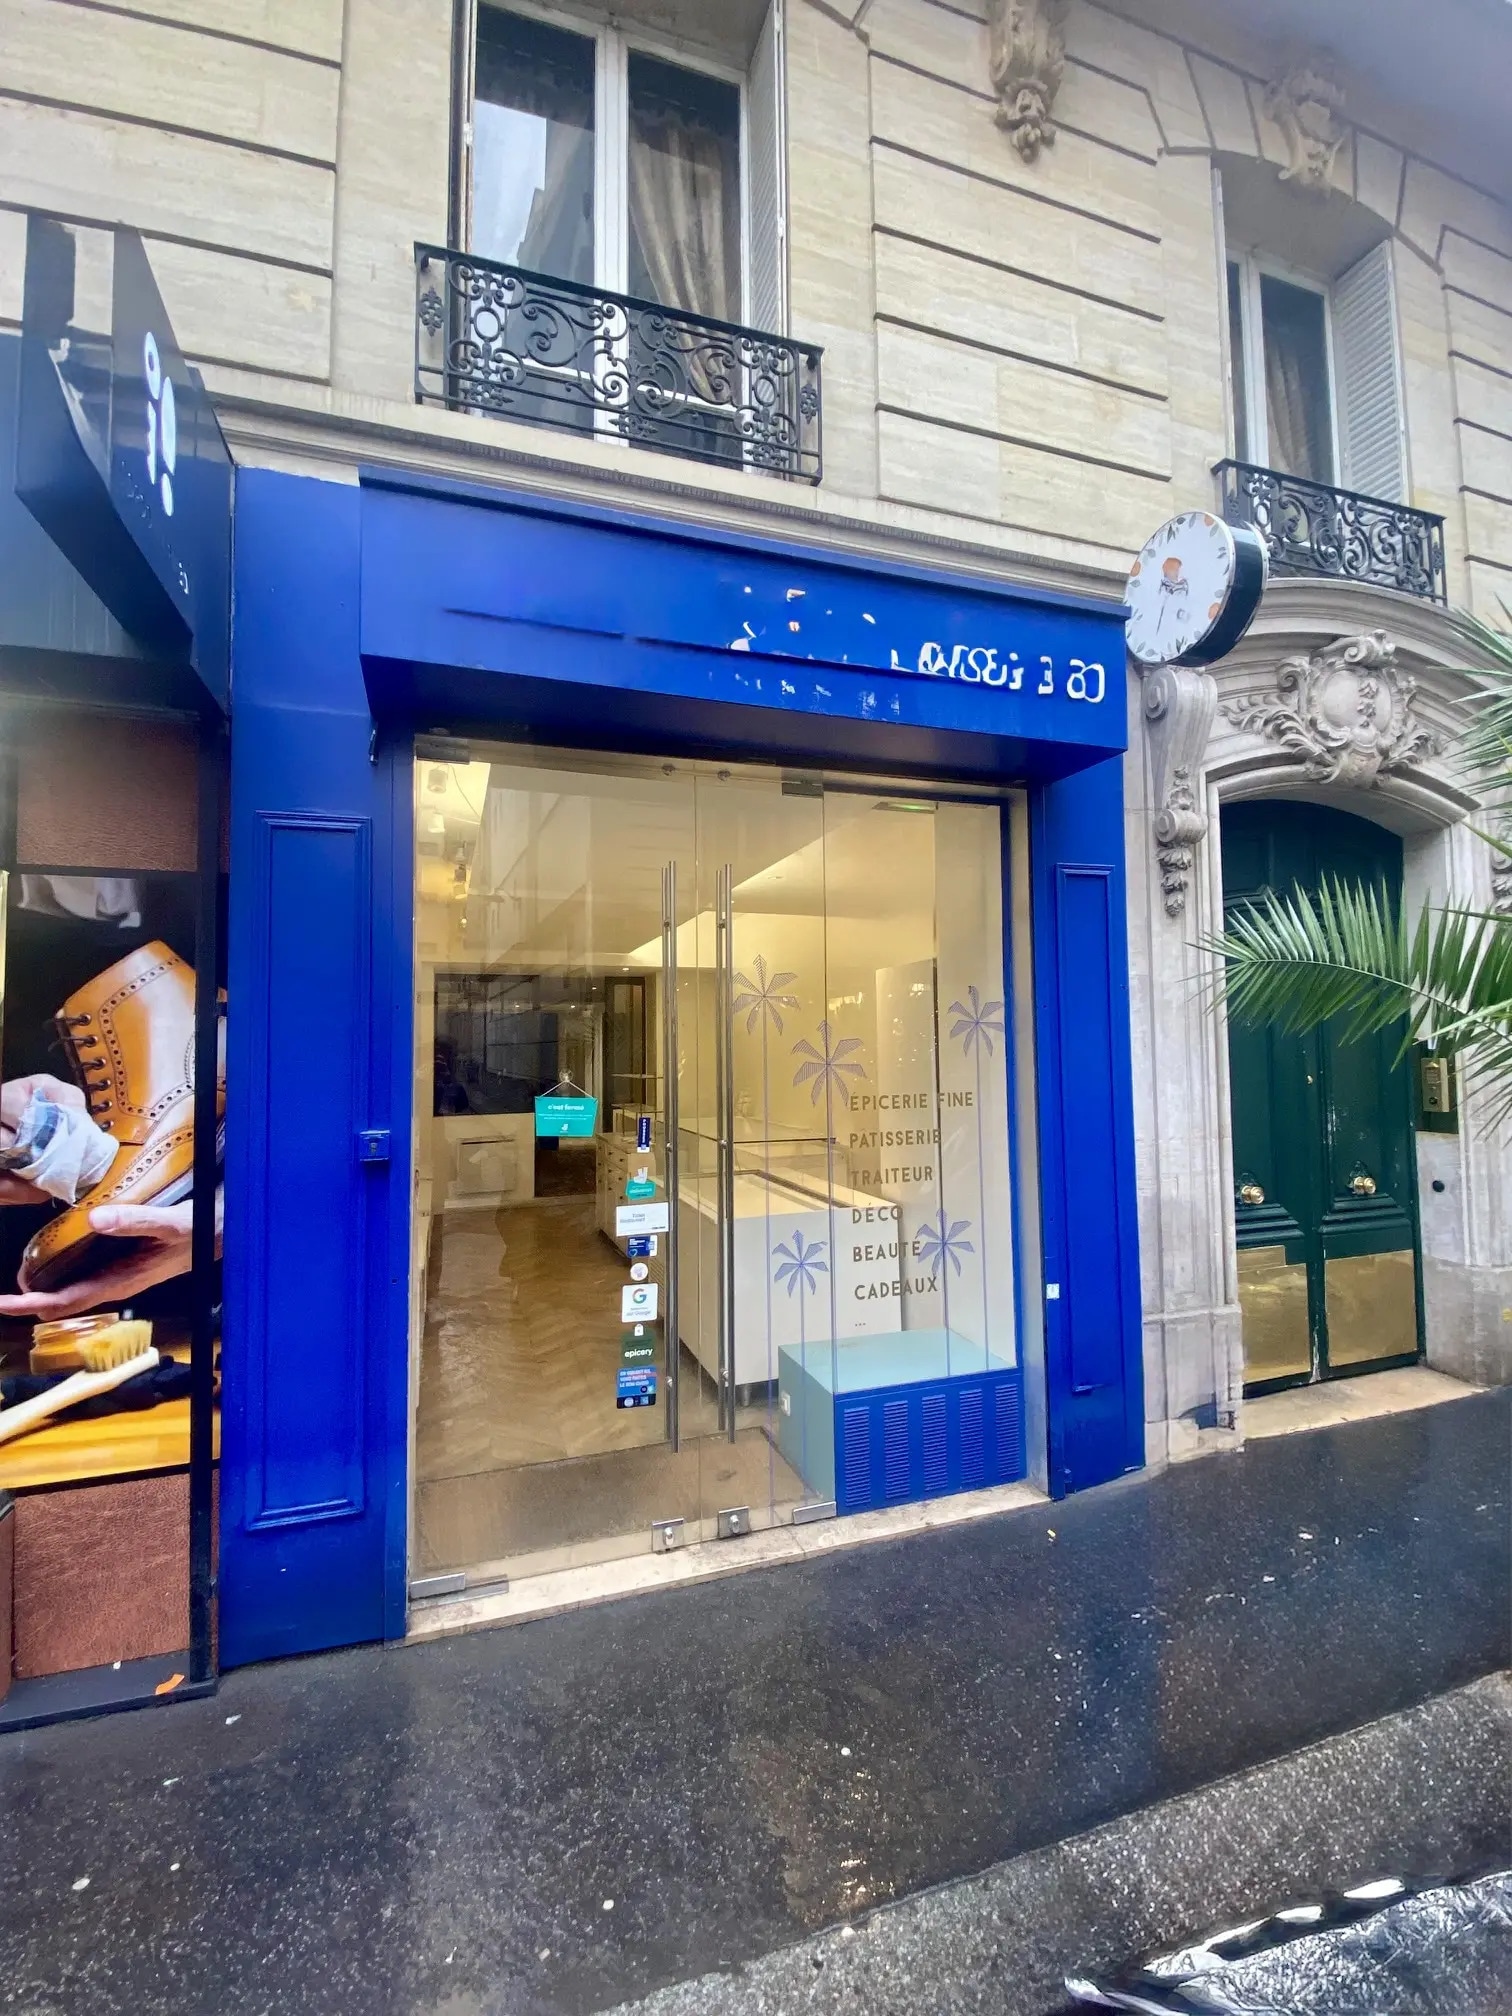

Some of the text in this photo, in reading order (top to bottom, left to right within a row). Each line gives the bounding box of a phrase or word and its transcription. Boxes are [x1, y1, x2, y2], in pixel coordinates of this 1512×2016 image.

[850, 1091, 974, 1111] ÉPICERIE FINE
[851, 1165, 933, 1187] TRAITEUR
[632, 1287, 647, 1304] G
[854, 1276, 939, 1301] CADEAUX
[624, 1348, 653, 1359] epicery
